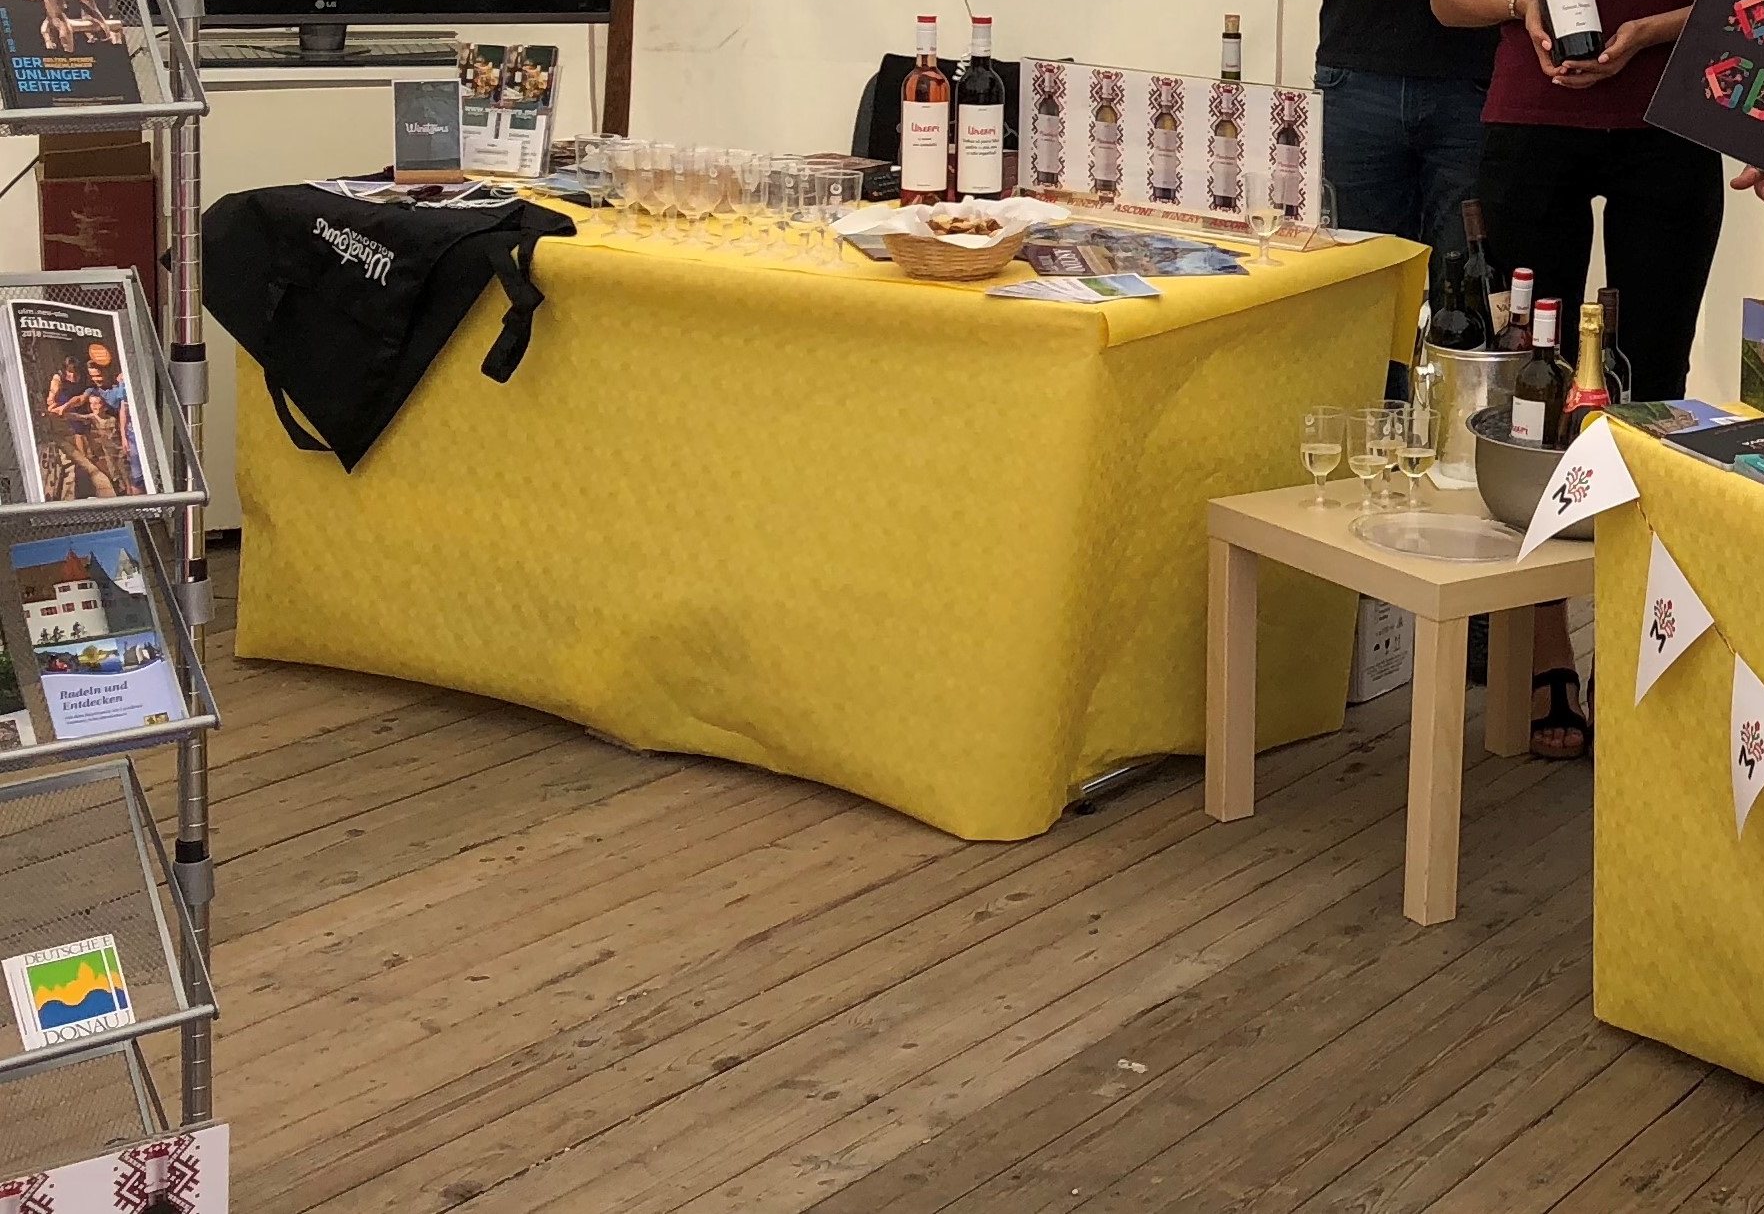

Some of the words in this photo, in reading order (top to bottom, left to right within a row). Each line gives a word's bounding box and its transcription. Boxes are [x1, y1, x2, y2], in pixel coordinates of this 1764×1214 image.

[12, 57, 43, 69] DER
[15, 70, 92, 81] UNLINGER
[18, 81, 72, 92] REITER
[1209, 218, 1250, 231] ASCON
[19, 316, 103, 338] führungen
[1552, 484, 1573, 515] M
[1650, 619, 1667, 654] M
[60, 686, 102, 701] Radeln
[104, 681, 128, 693] und
[62, 694, 123, 712] Entdecken
[1738, 745, 1756, 779] M
[24, 938, 101, 966] DEUTSCHE
[42, 1013, 120, 1048] DONAU
